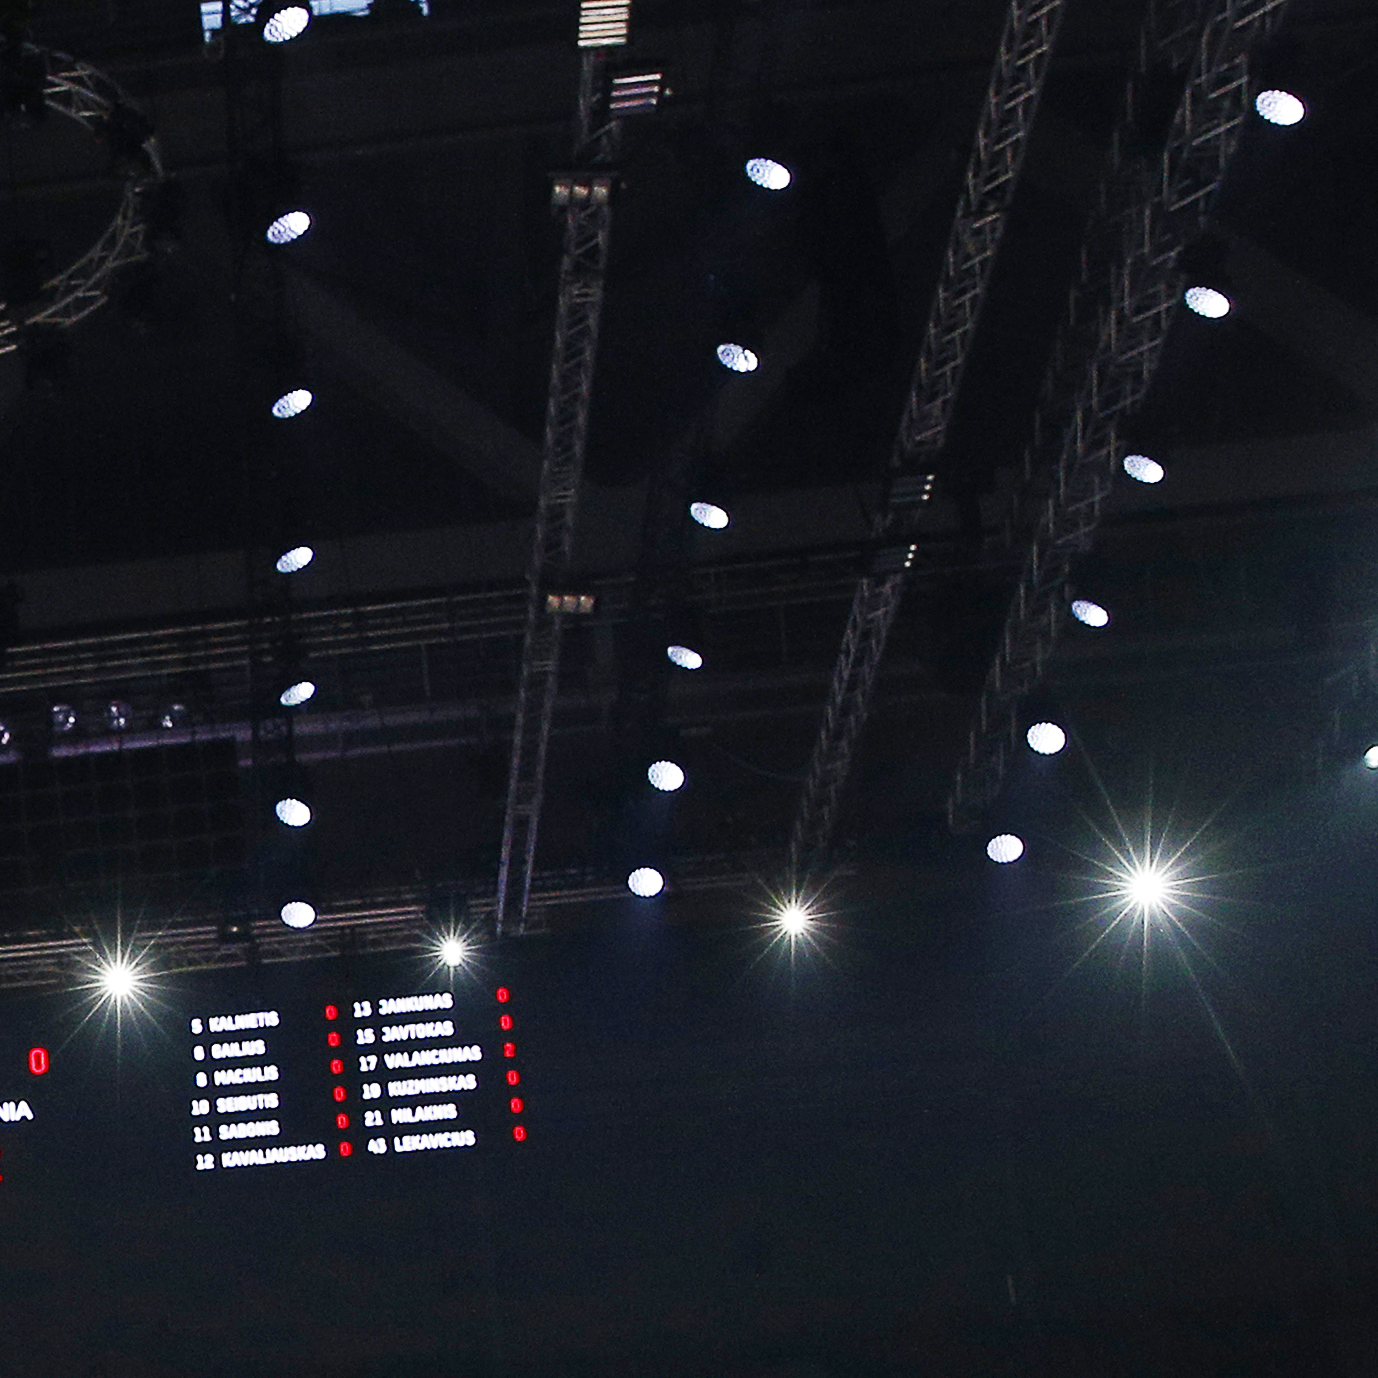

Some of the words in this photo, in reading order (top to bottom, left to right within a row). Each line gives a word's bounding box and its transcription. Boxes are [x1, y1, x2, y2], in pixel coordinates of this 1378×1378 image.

[192, 1019, 202, 1034] 5
[354, 1001, 372, 1017] 13
[357, 1028, 375, 1044] 15
[382, 1021, 454, 1042] JAVTOKAS
[29, 1048, 48, 1074] 0
[359, 1055, 377, 1071] 17
[191, 1100, 209, 1115] 10
[194, 1126, 212, 1142] 11
[365, 1110, 383, 1126] 21
[196, 1154, 214, 1170] 12
[368, 1138, 387, 1154] 43
